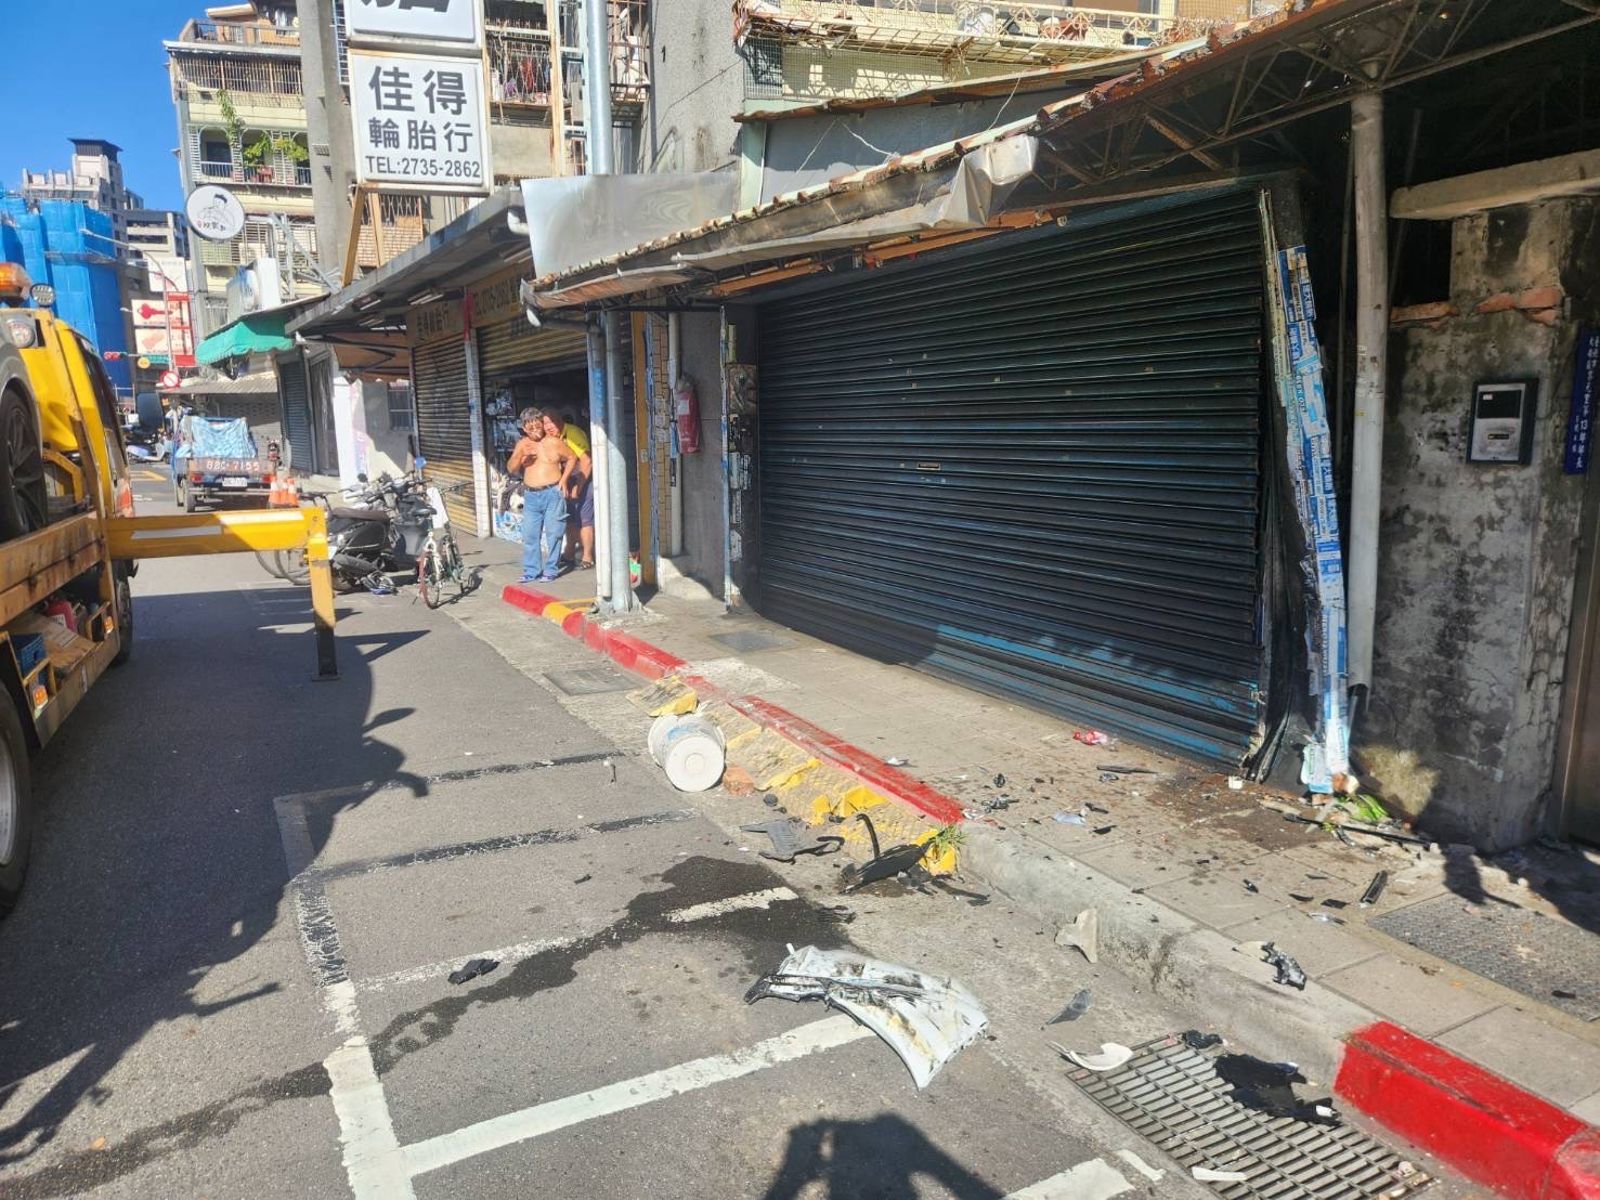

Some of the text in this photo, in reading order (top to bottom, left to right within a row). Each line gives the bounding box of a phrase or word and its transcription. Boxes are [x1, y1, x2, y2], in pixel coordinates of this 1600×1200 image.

[368, 65, 468, 116] 佳得
[368, 116, 473, 153] 輪胎行
[365, 155, 481, 178] TEL:2735-2862
